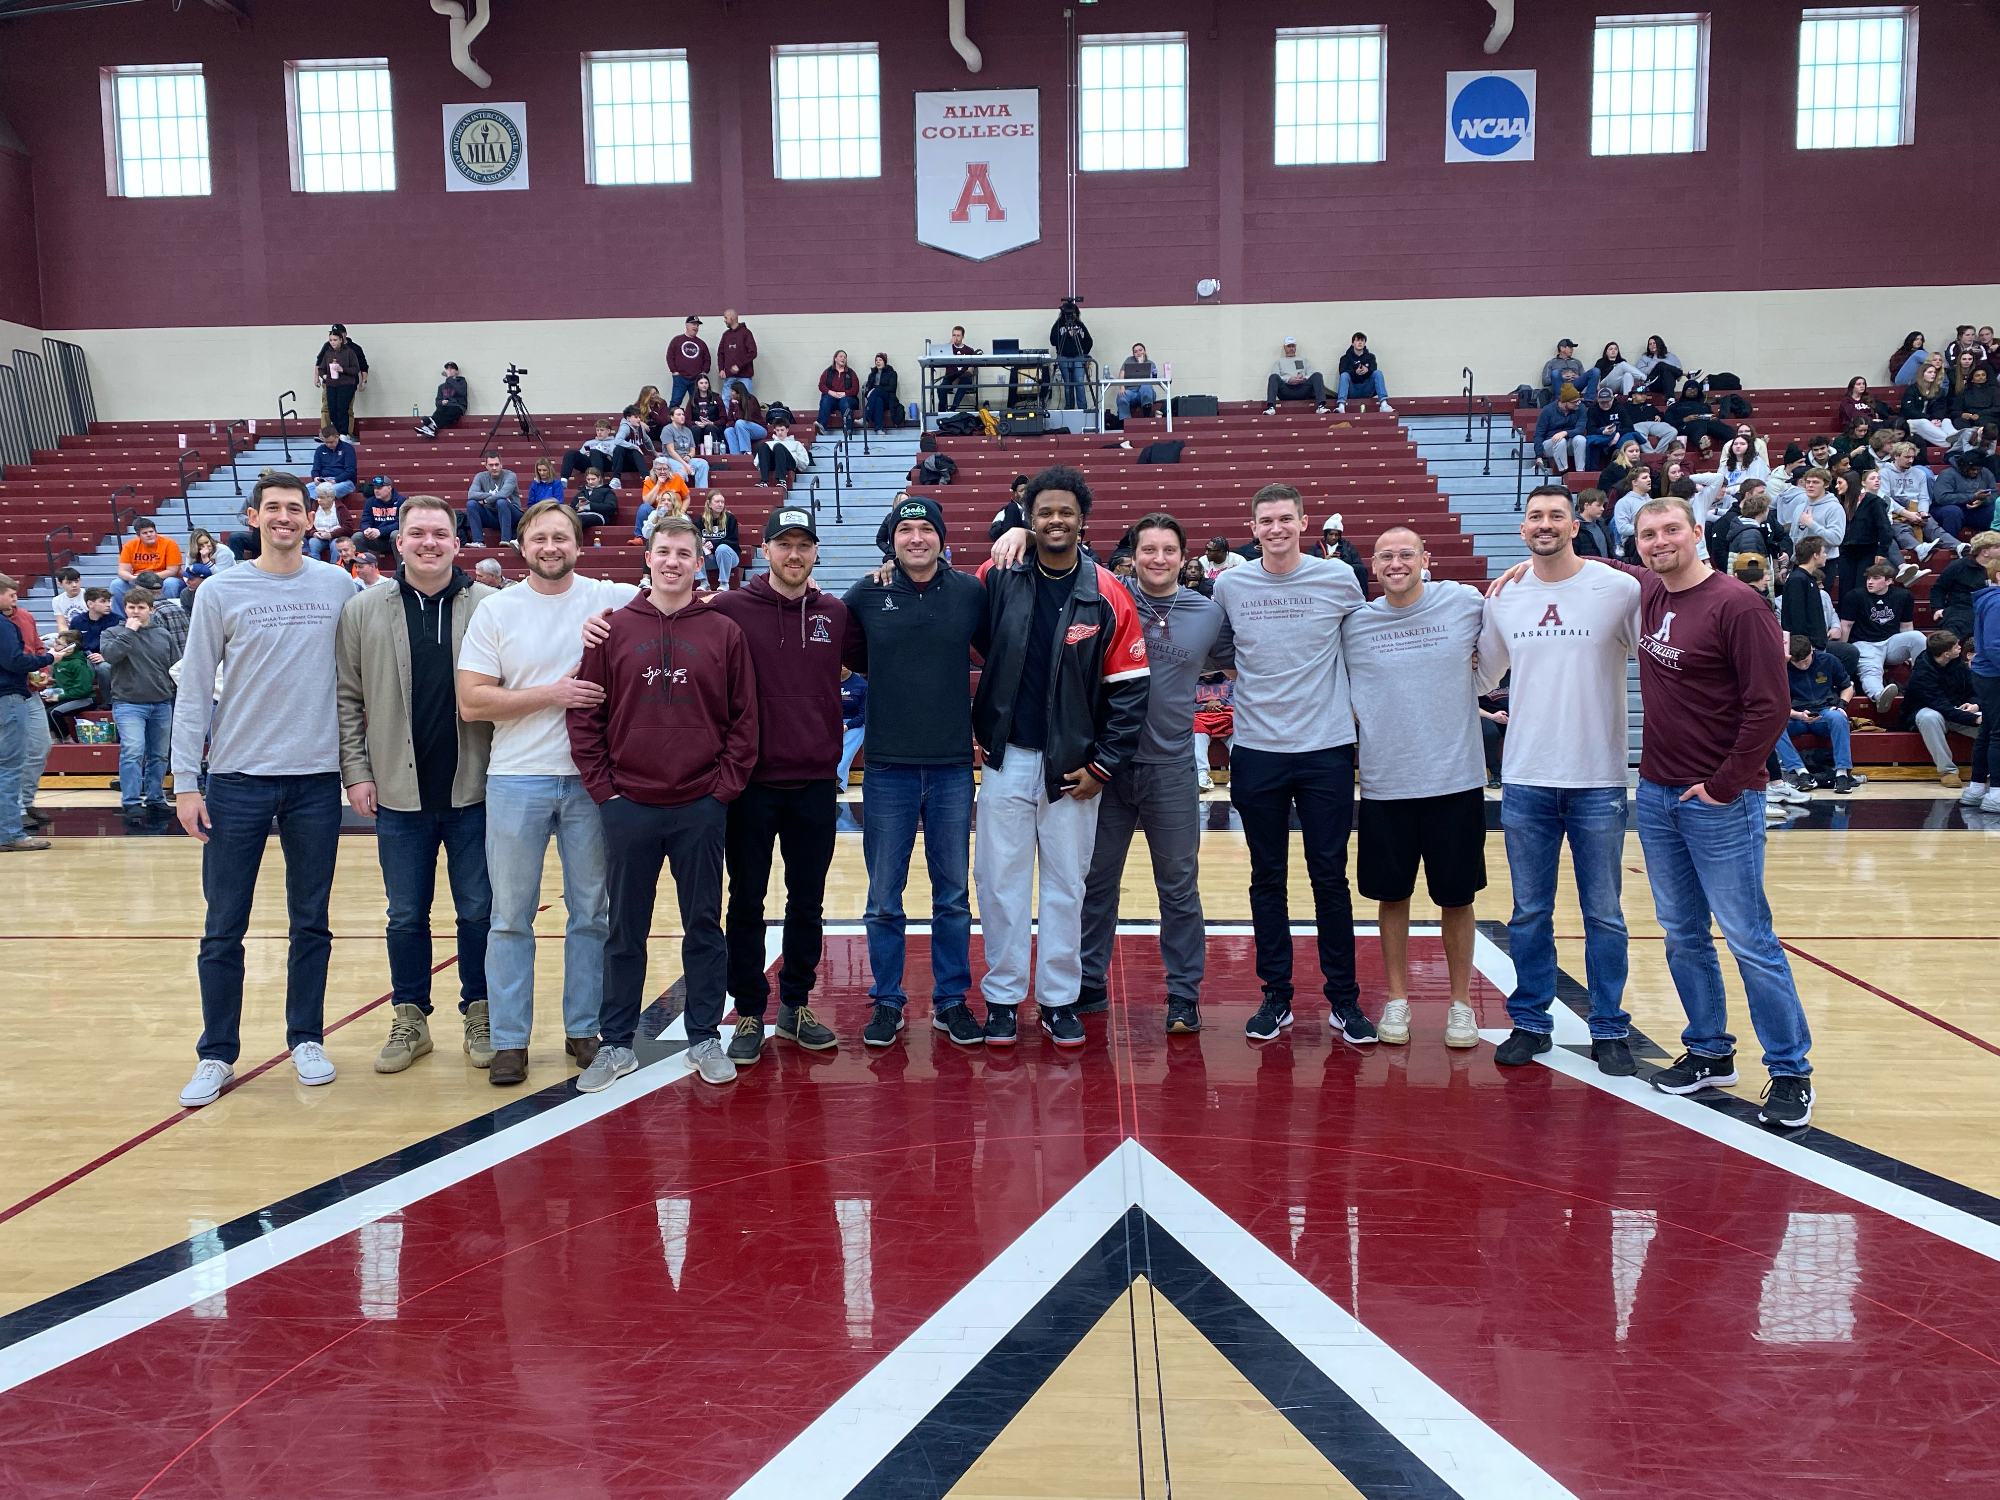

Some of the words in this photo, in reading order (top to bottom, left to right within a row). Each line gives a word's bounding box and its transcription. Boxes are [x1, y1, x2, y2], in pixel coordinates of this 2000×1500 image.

[943, 104, 1012, 118] ALMA
[453, 117, 471, 152] MICHIGAN
[471, 112, 519, 150] INTERCOLLEGIATE
[921, 124, 1034, 139] COLLEGE
[1458, 117, 1526, 139] NCAA
[466, 143, 507, 163] MIAA
[454, 154, 482, 181] ATHLETIC
[481, 151, 519, 182] ASSOCIATION
[949, 161, 1007, 223] A
[247, 605, 274, 617] ALMA
[275, 603, 332, 612] BASKETBALL
[1240, 600, 1262, 609] ALMA
[1263, 597, 1315, 607] BASKETBALL
[1538, 603, 1563, 627] A
[813, 619, 829, 638] A
[1370, 633, 1393, 643] ALMA
[1394, 625, 1449, 639] BASKETBALL
[1513, 629, 1591, 639] BASKETBALL
[1651, 611, 1677, 643] A
[1146, 640, 1191, 660] COLLEGE
